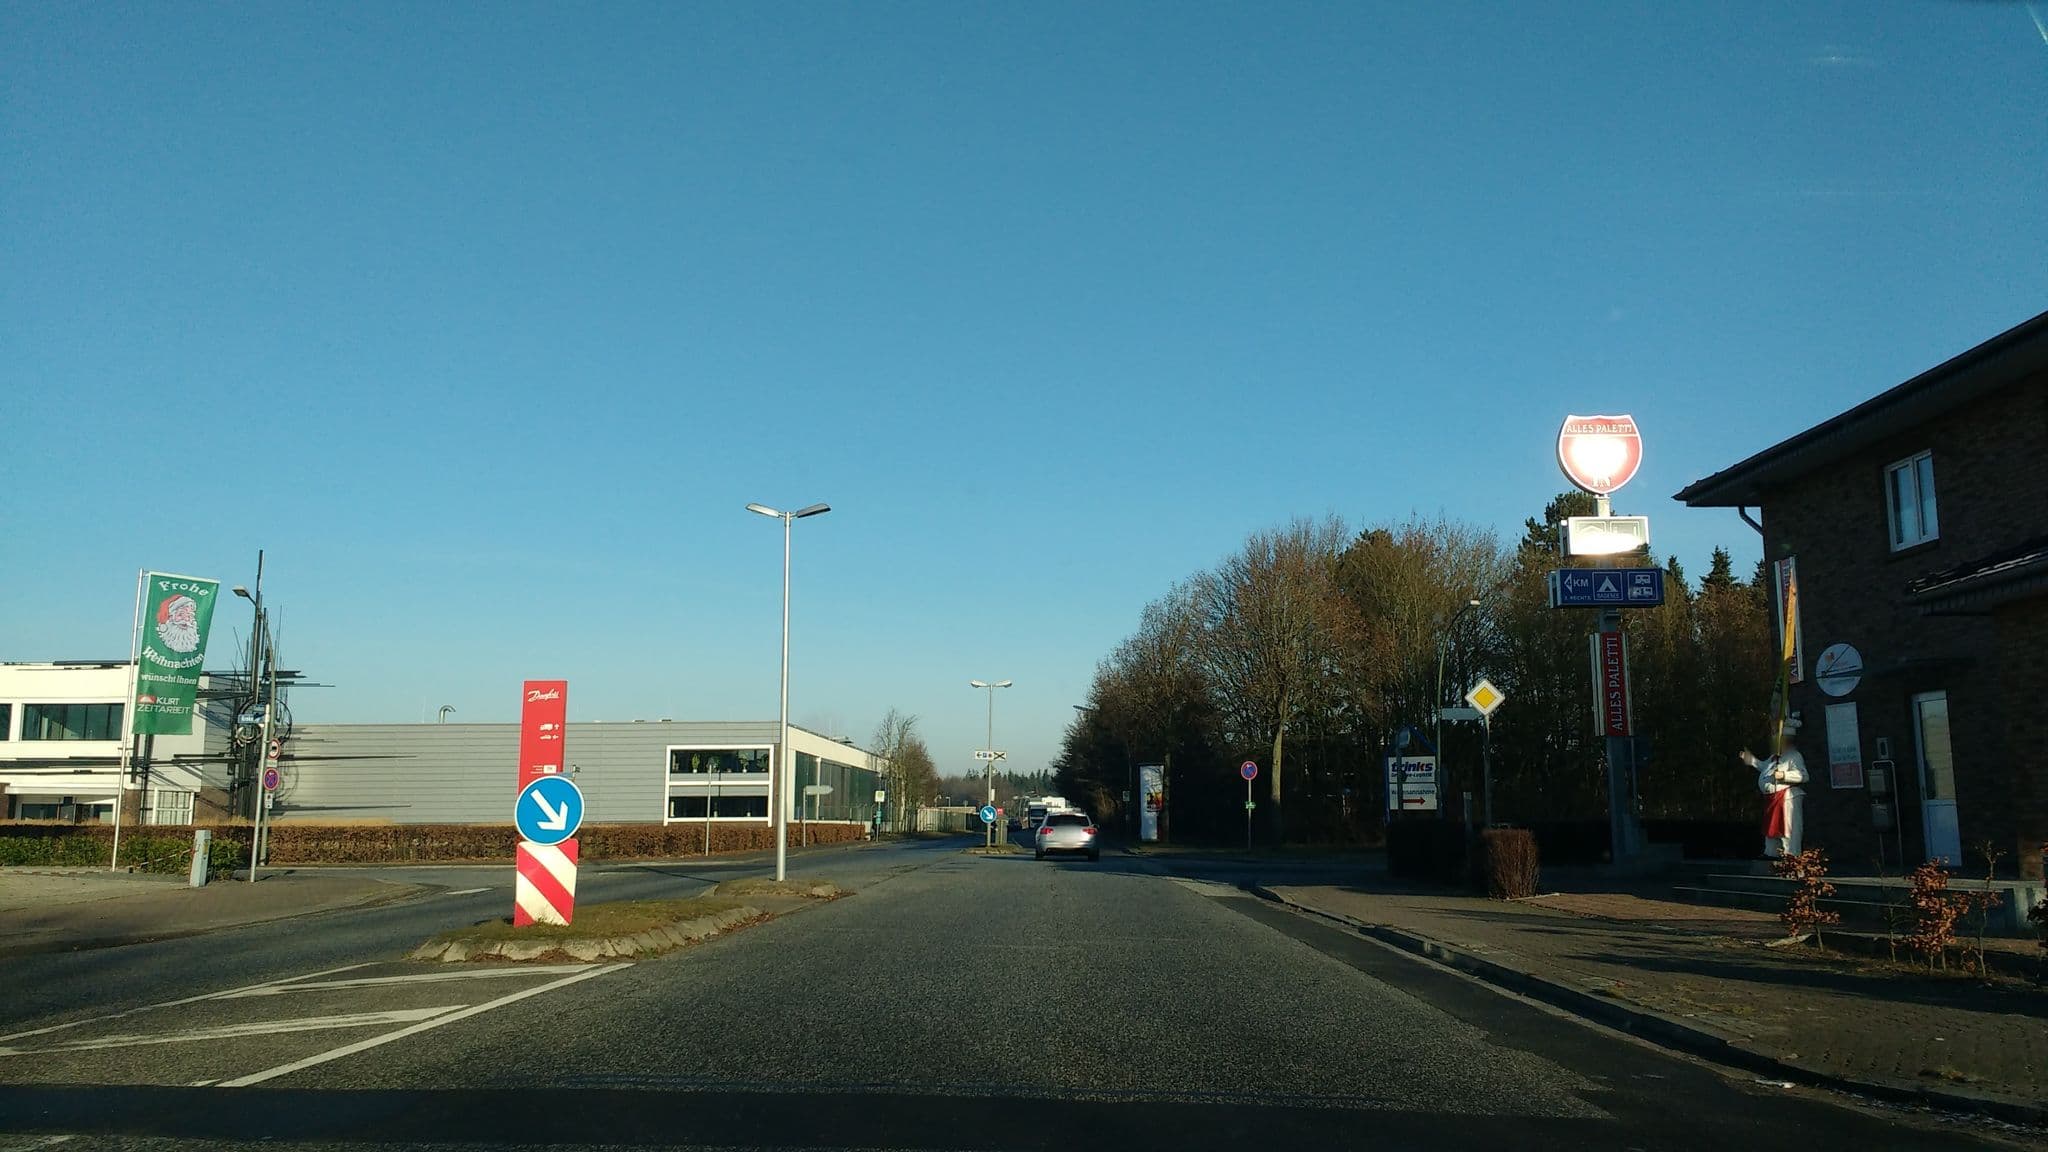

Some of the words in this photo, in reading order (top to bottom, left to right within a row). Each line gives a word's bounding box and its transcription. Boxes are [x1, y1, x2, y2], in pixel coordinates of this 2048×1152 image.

[1566, 424, 1594, 433] ALLES
[1596, 424, 1632, 433] PALETTI
[158, 581, 209, 596] Frohe
[142, 645, 205, 669] Weihnachten
[1607, 637, 1620, 688] PALETTI
[141, 672, 176, 683] wünscht
[156, 696, 180, 705] KURT
[137, 704, 191, 714] ZEITARBEIT
[1610, 691, 1623, 731] ALLES
